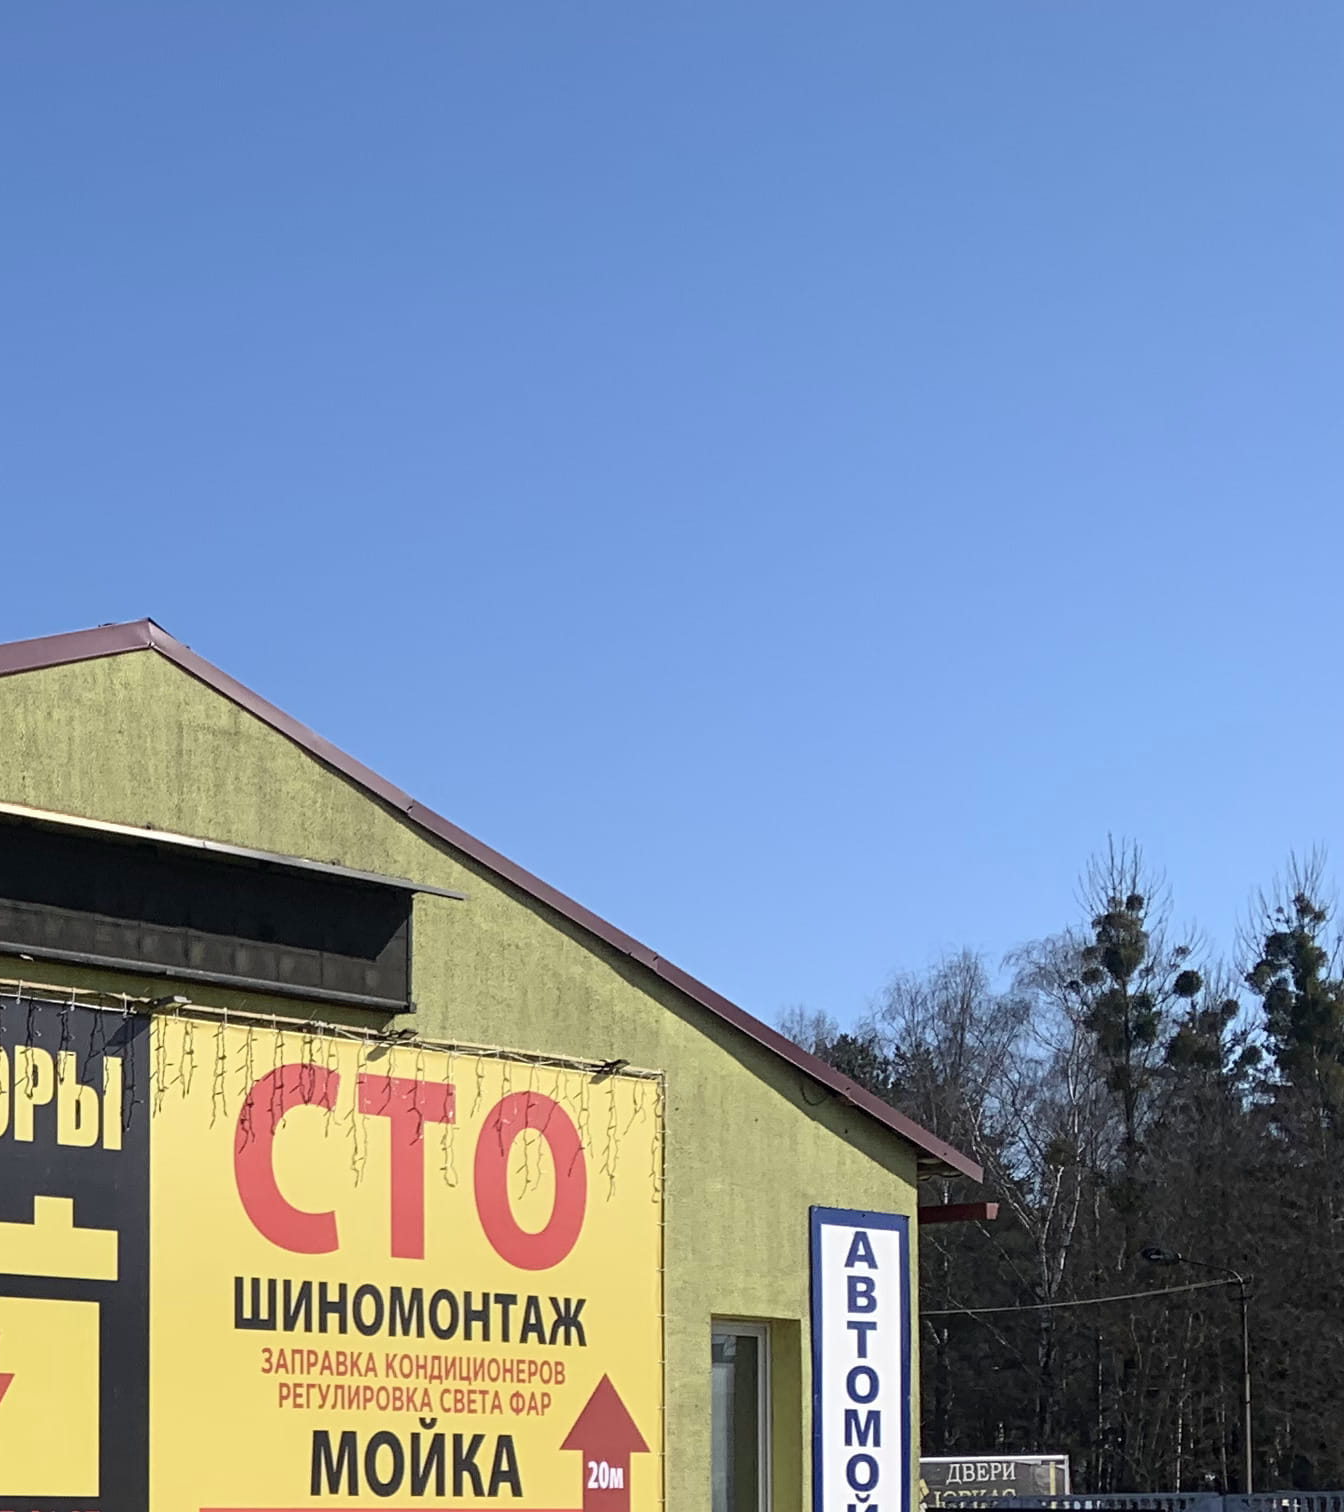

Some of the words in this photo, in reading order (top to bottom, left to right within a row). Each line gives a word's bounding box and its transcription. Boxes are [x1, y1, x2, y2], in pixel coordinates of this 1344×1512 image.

[233, 1062, 588, 1271] СТО
[233, 1276, 588, 1347] ШИНОМОНТАЖ
[261, 1347, 378, 1378] ЗАПРАВКА
[385, 1353, 566, 1385] КОНДИЦИОНЕРОВ
[278, 1382, 433, 1412] РЕГУЛИРОВКА
[440, 1388, 504, 1415] СВЕТА
[509, 1390, 552, 1416] ФАР
[310, 1417, 523, 1498] МОЙКА
[587, 1460, 624, 1490] 20м
[946, 1462, 1016, 1485] ДВЕРИ
